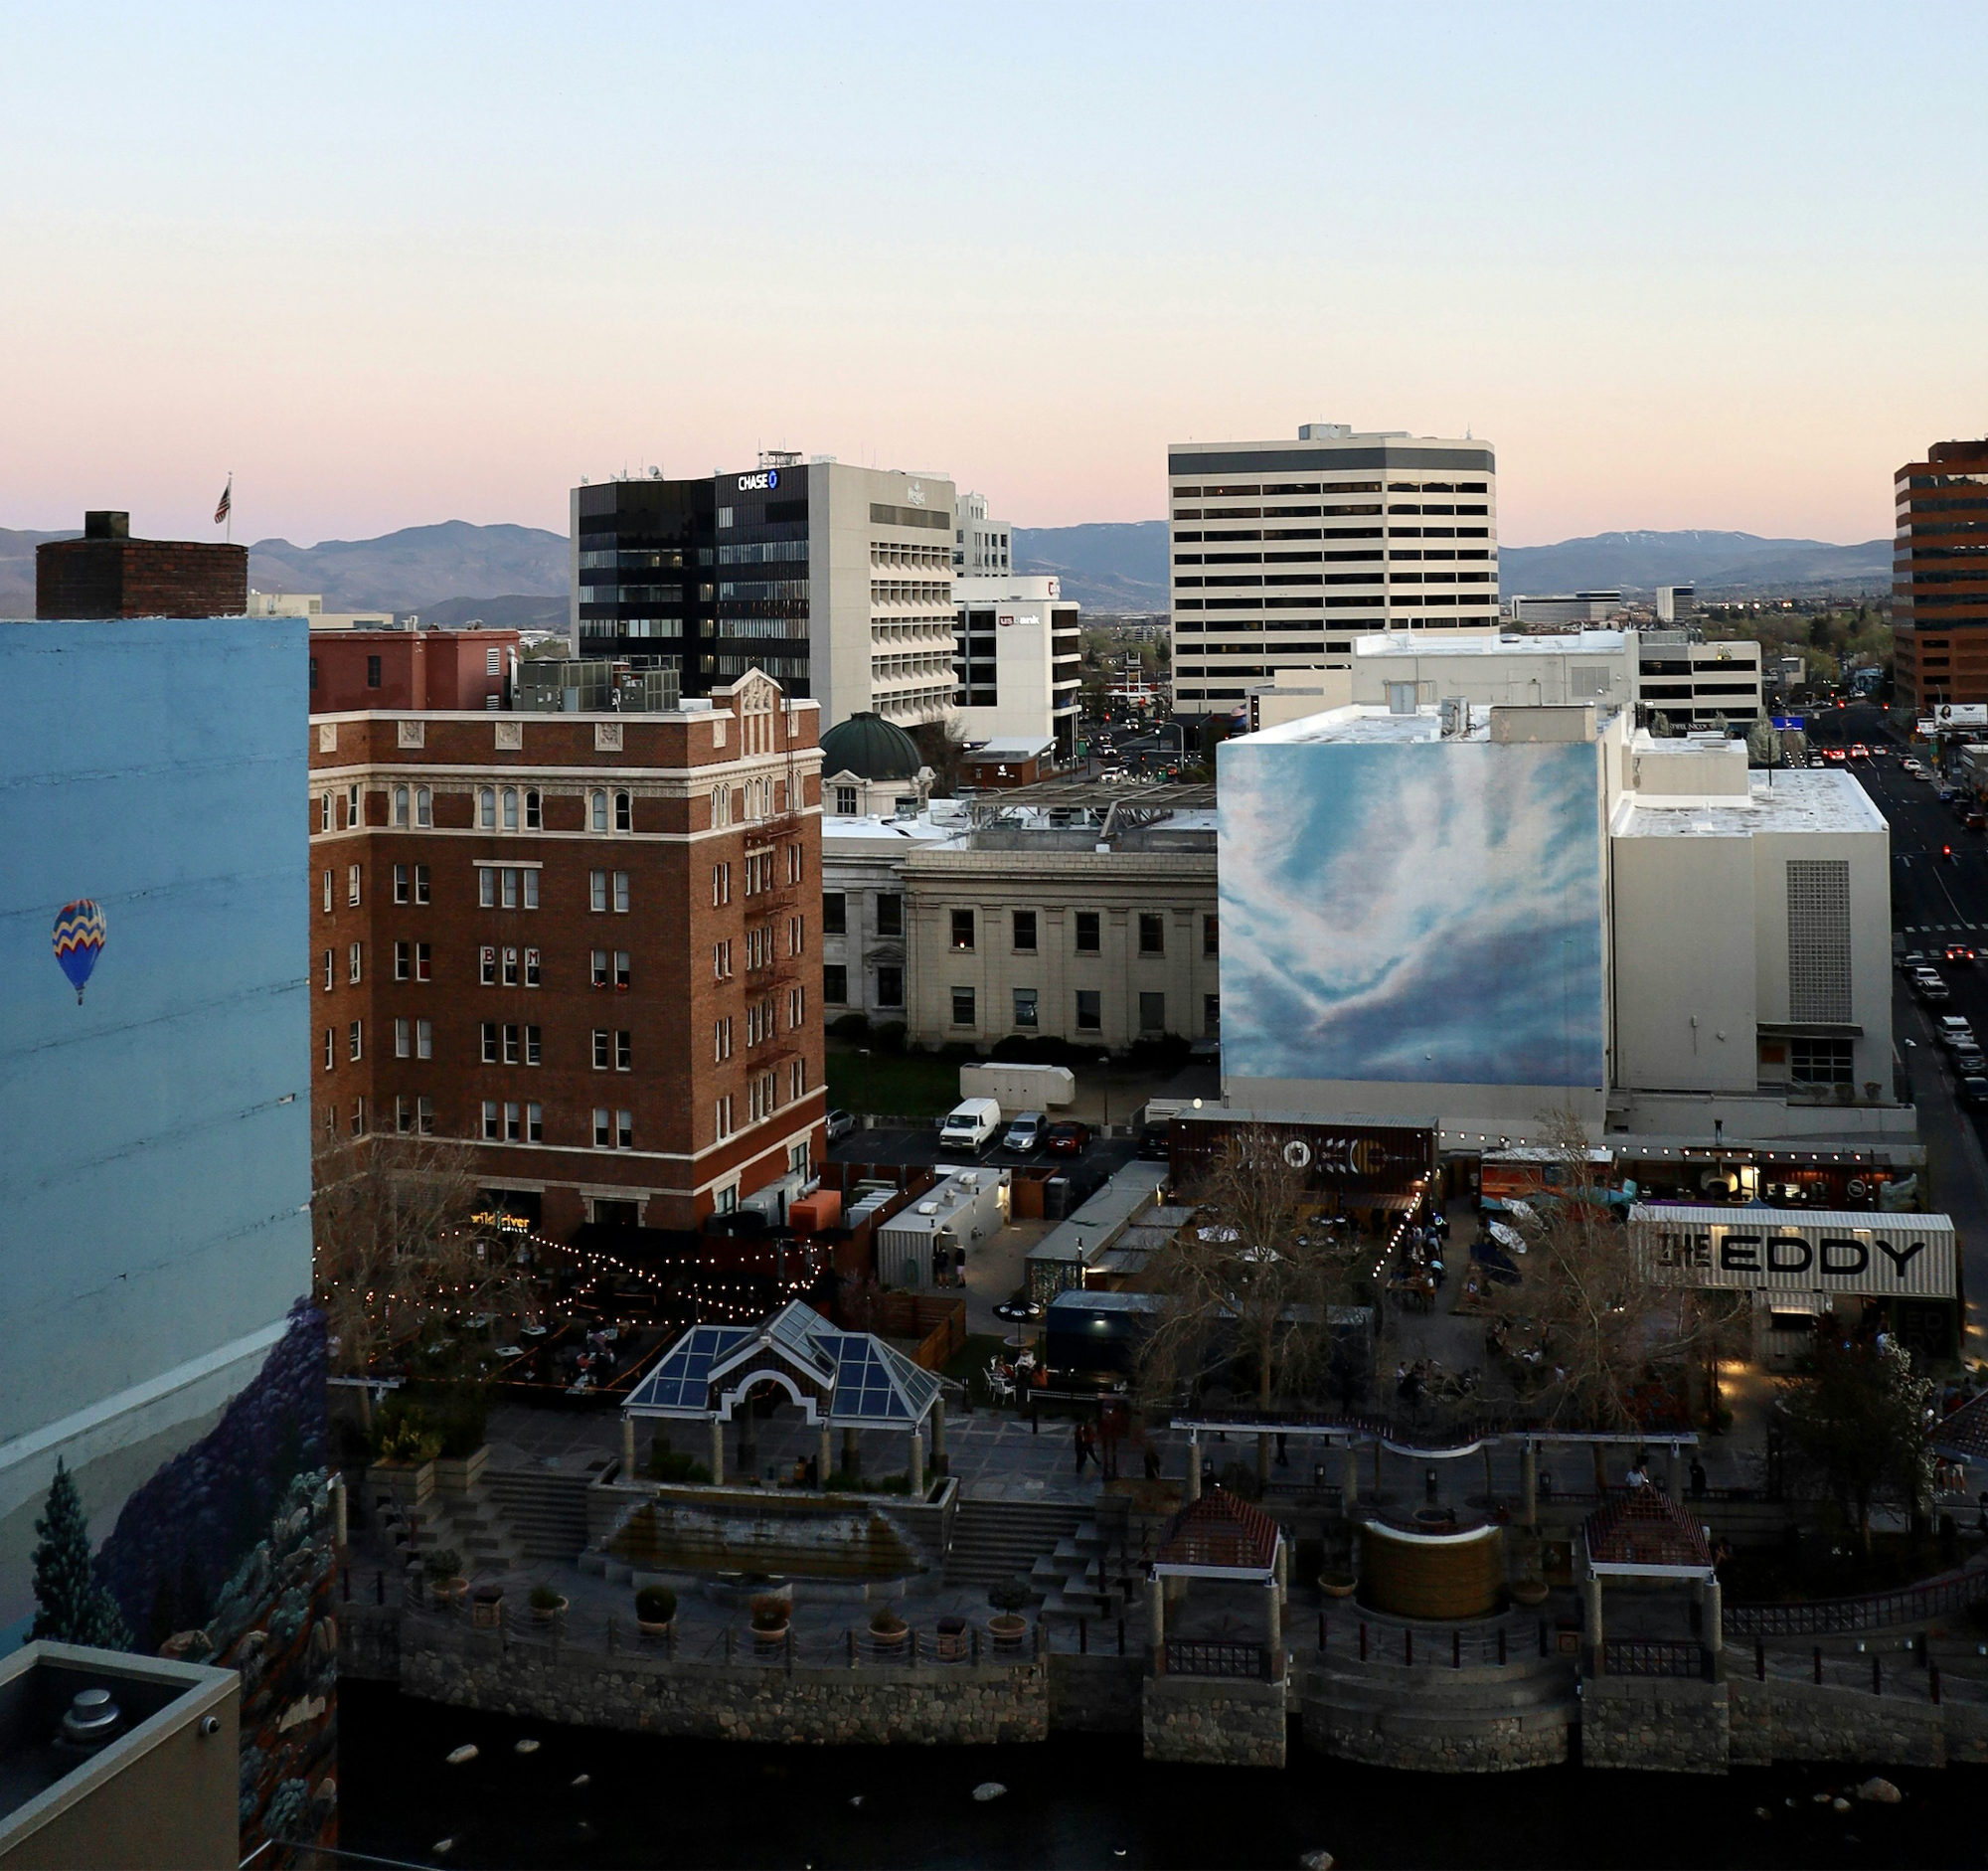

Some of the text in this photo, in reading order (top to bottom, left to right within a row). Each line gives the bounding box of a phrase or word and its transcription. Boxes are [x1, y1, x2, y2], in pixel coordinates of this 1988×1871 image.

[739, 473, 768, 491] CHASE
[501, 1214, 530, 1227] river
[1657, 1233, 1925, 1277] THE EDDY
